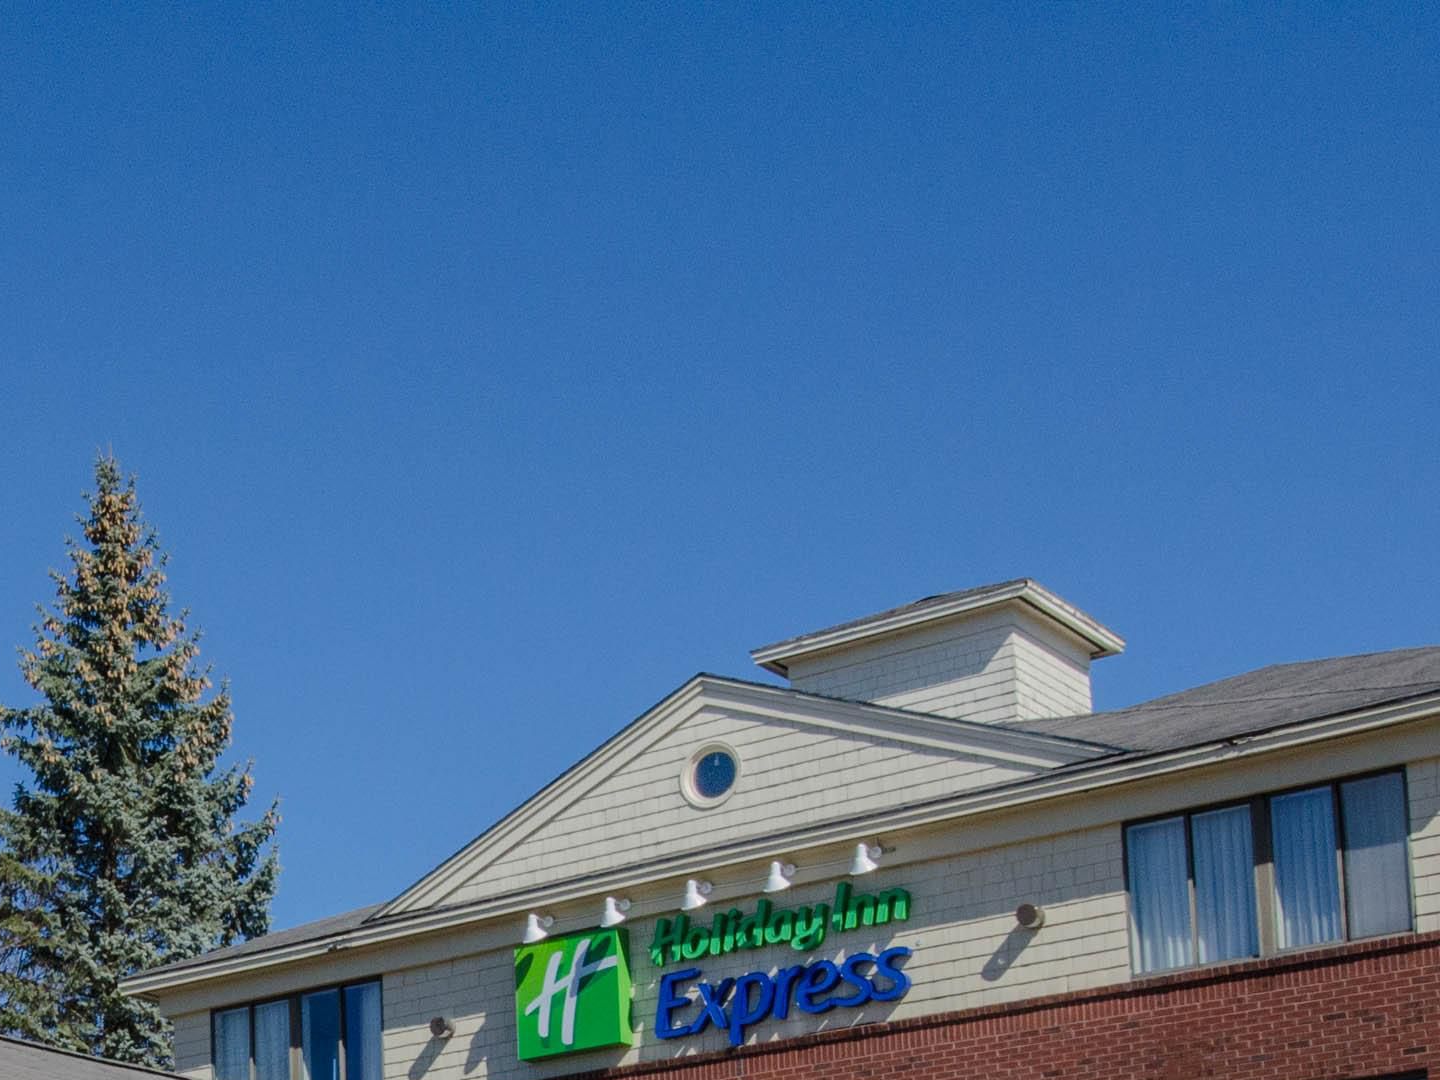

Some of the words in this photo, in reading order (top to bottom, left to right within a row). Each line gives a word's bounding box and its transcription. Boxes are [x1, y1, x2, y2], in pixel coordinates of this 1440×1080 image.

[649, 899, 829, 967] Holiday
[832, 881, 912, 932] Inn
[655, 946, 913, 1047] Express
